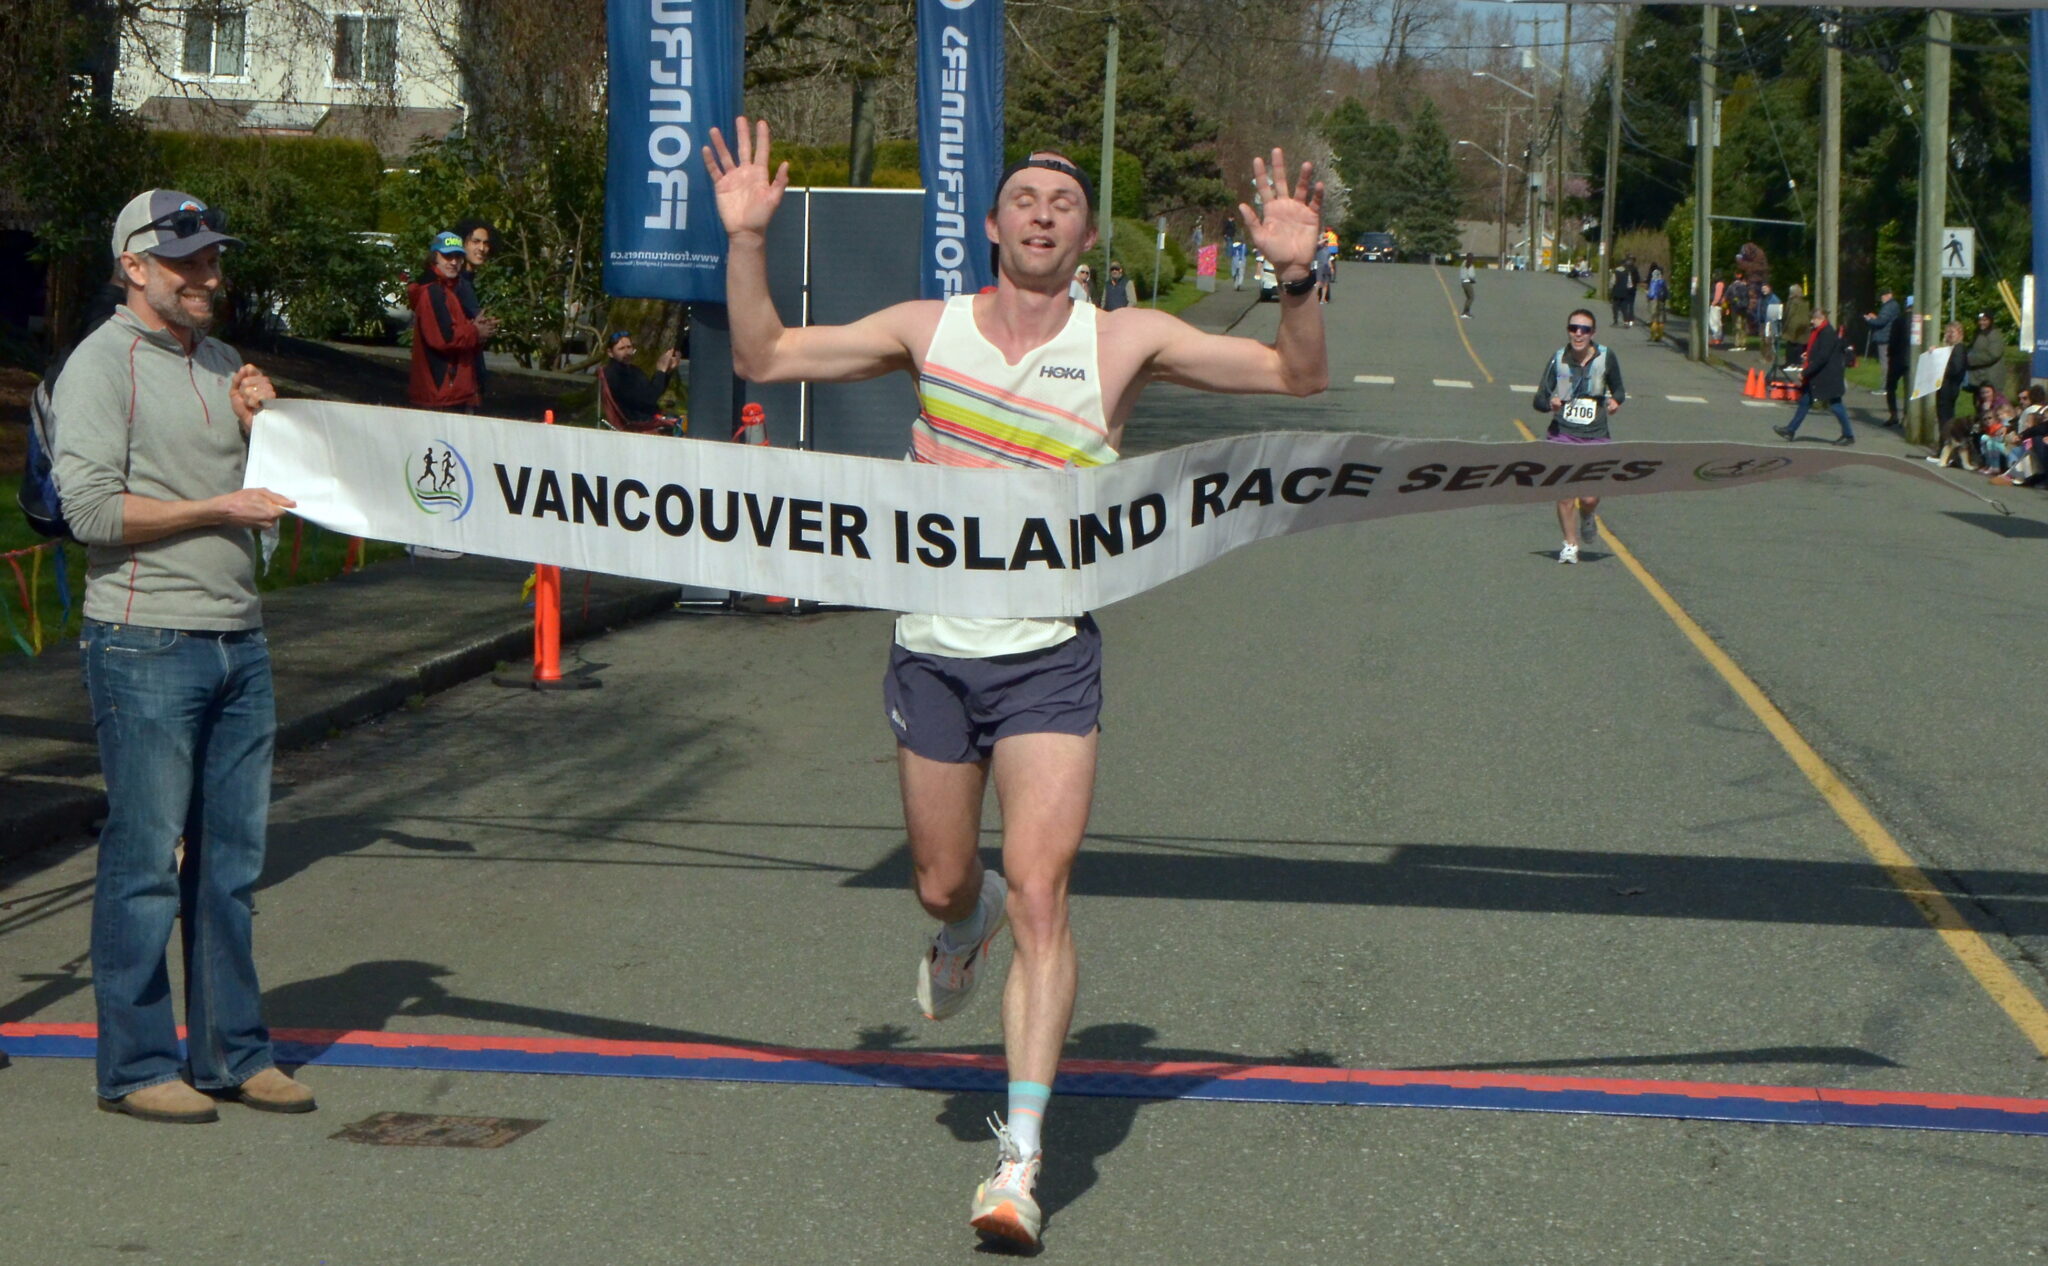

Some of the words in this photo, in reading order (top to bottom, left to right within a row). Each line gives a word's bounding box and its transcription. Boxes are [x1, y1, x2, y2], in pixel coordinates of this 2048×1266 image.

[1039, 365, 1086, 381] HOKA
[1565, 405, 1594, 419] 3106
[493, 463, 871, 560] VANCOUVER
[894, 493, 1167, 571] ISLAND
[1190, 462, 1383, 528] RACE
[1397, 459, 1664, 494] SERIES
